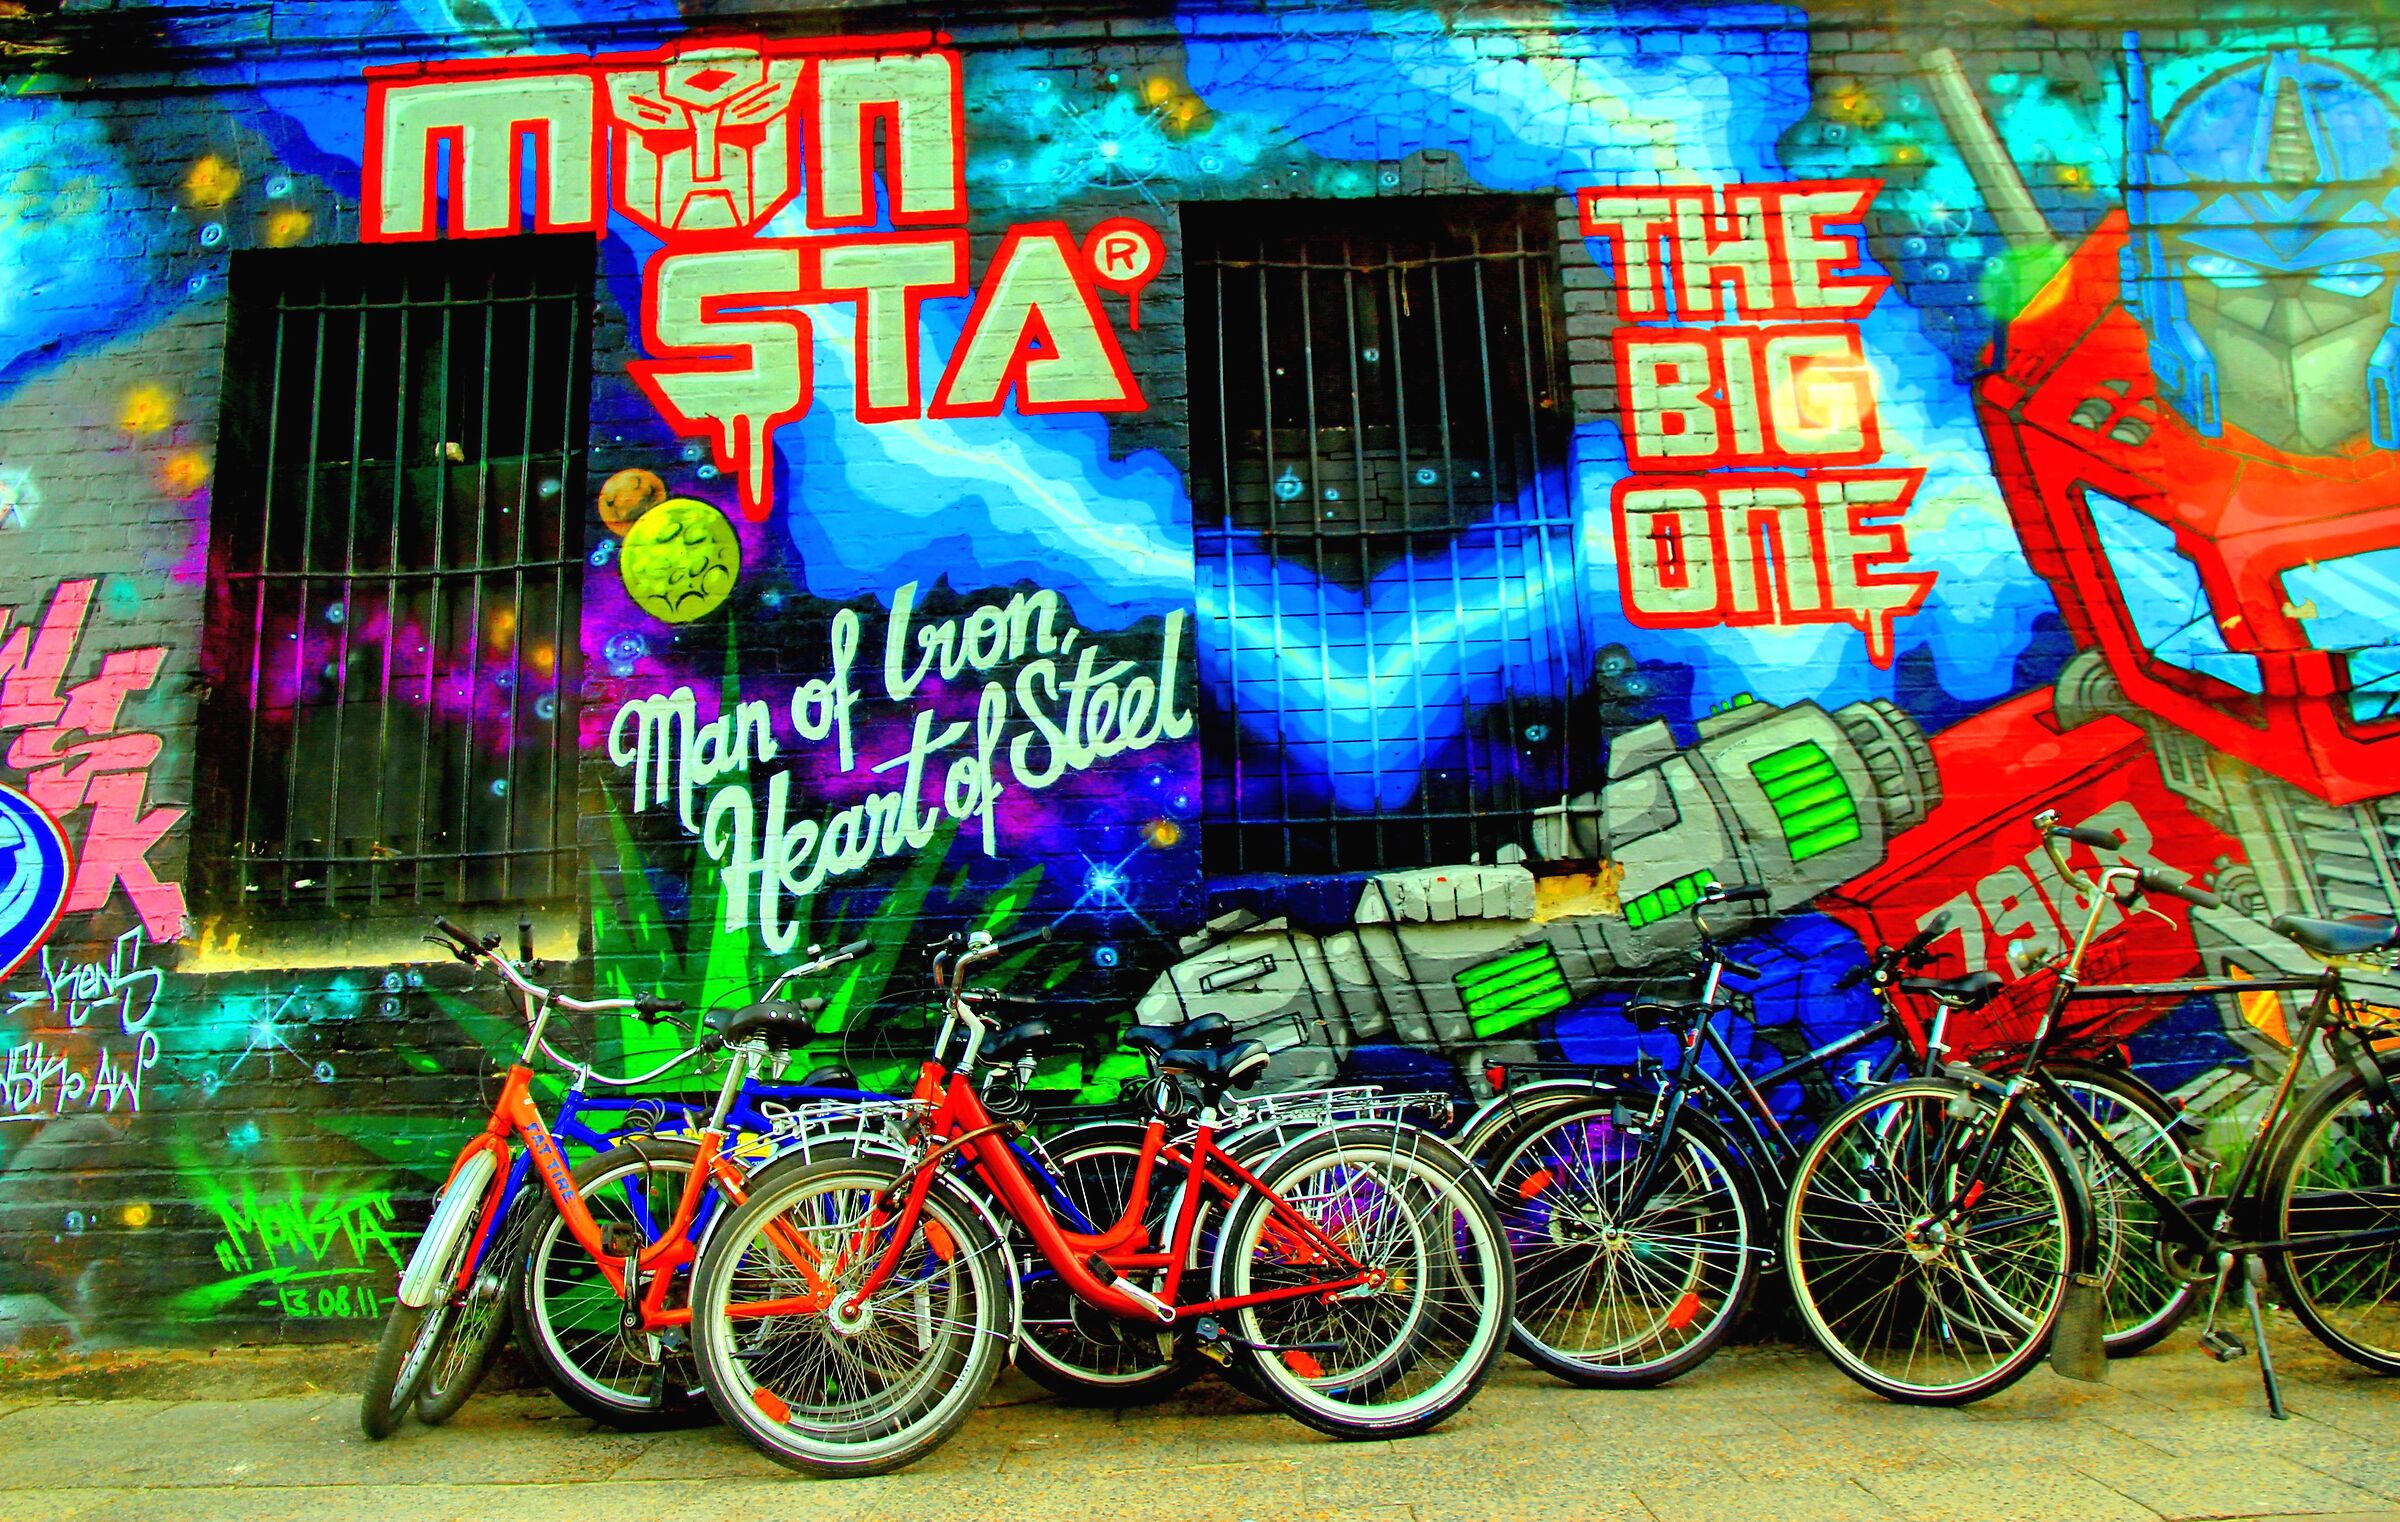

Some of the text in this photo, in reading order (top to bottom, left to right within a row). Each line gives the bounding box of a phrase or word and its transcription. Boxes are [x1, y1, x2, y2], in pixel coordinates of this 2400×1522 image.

[1577, 178, 1892, 321] THE
[630, 222, 1144, 512] STA
[1612, 323, 1882, 471] BIG
[1611, 467, 1939, 660] ONE
[608, 686, 776, 834] Man
[790, 608, 860, 773] of
[703, 608, 1194, 956] Heart of Steel
[526, 1122, 577, 1205] FAT TIRE
